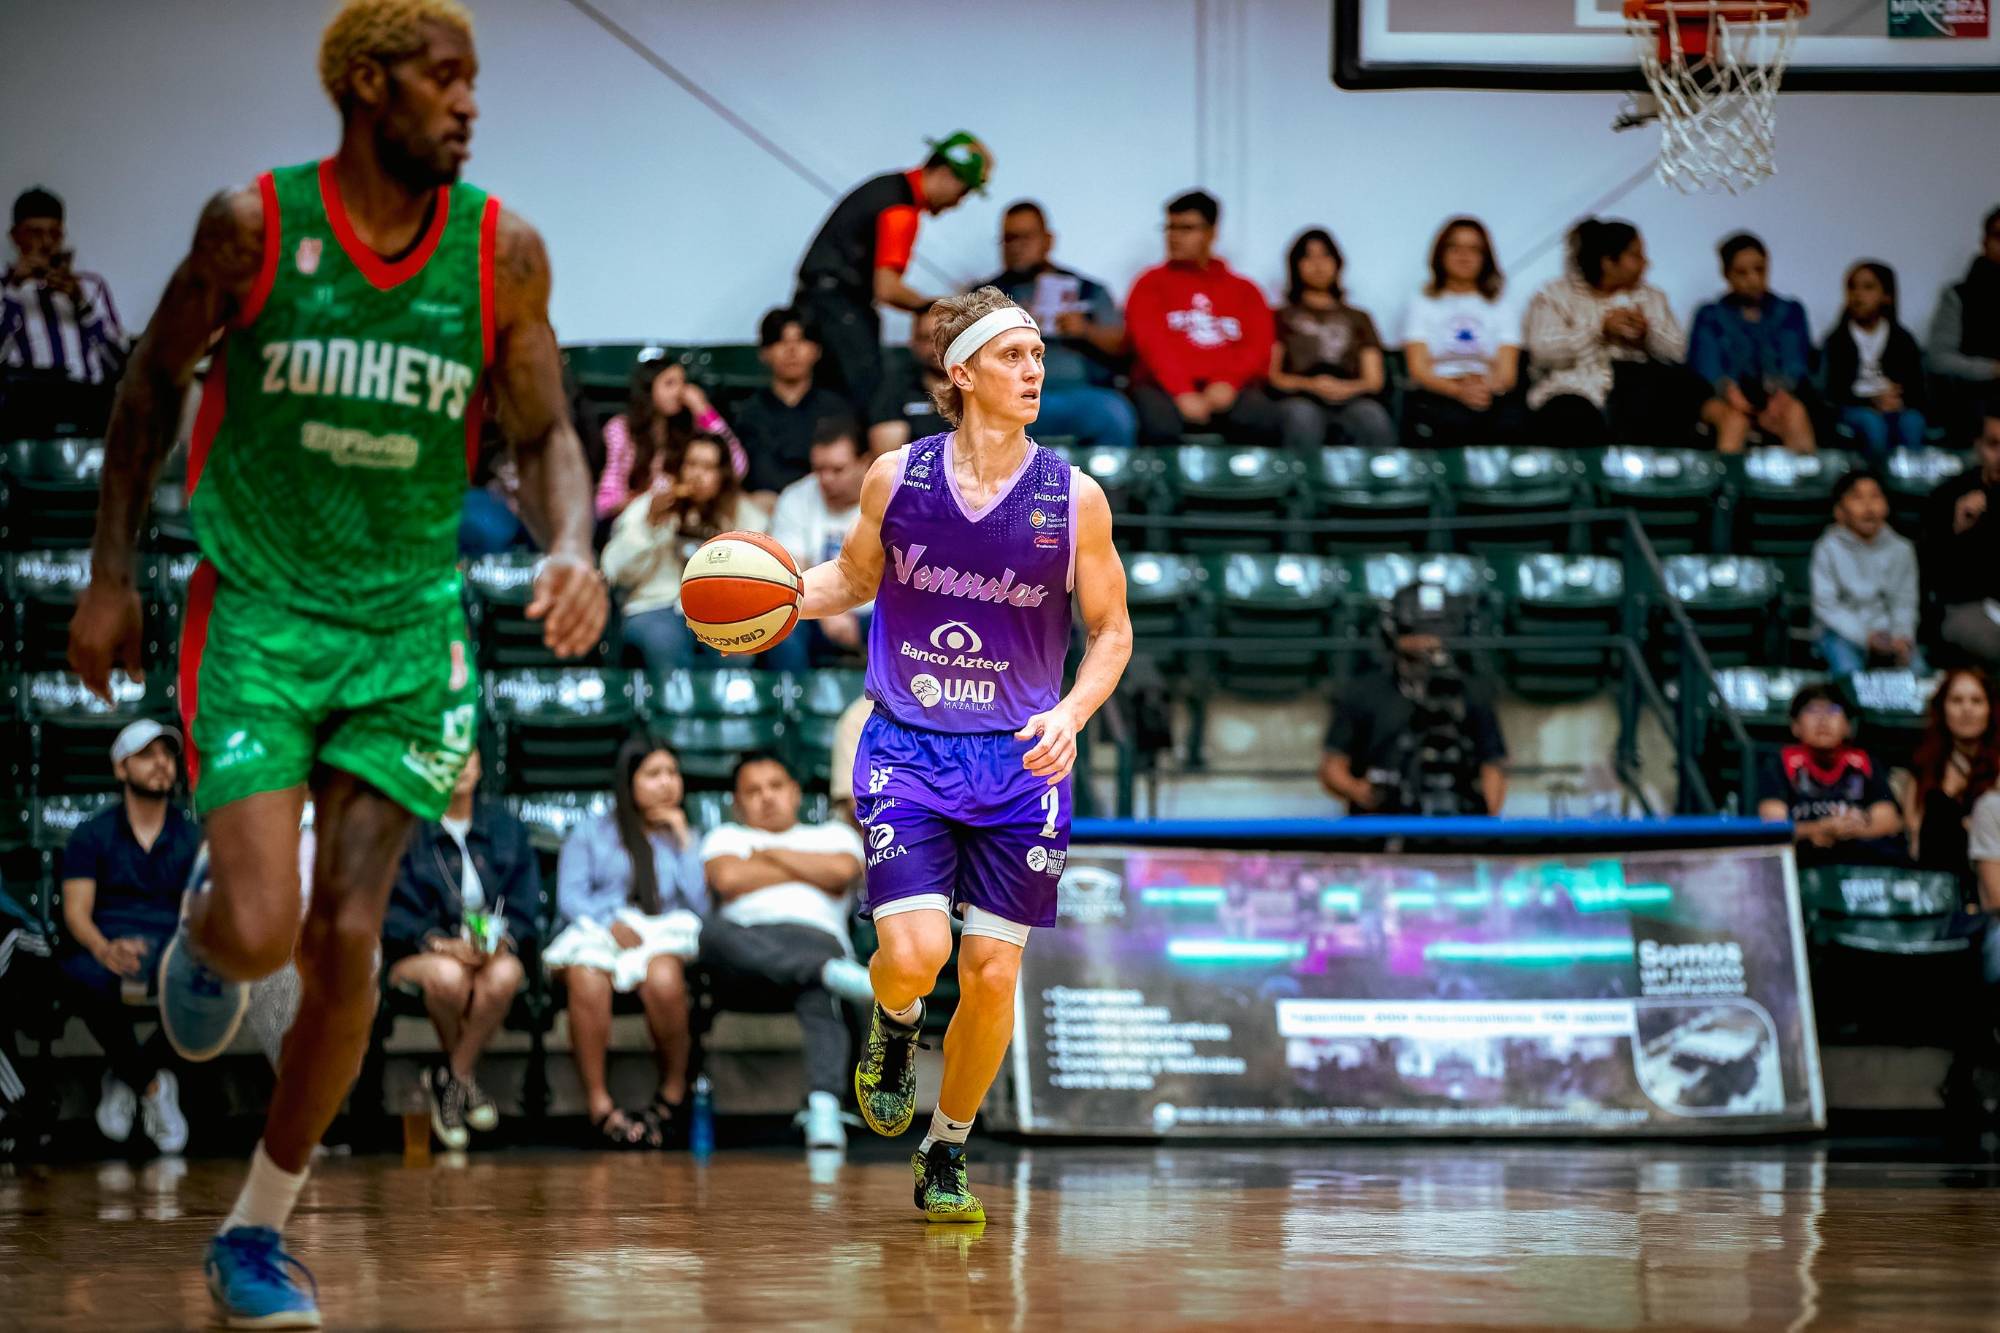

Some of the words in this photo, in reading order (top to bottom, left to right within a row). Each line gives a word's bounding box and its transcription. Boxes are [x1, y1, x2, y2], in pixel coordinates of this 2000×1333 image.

[262, 338, 473, 420] ZONKEYS
[893, 544, 1048, 607] Venados
[901, 641, 949, 666] Banco
[952, 654, 1010, 673] Azteca
[944, 678, 996, 703] UAD
[867, 844, 908, 870] MEGA
